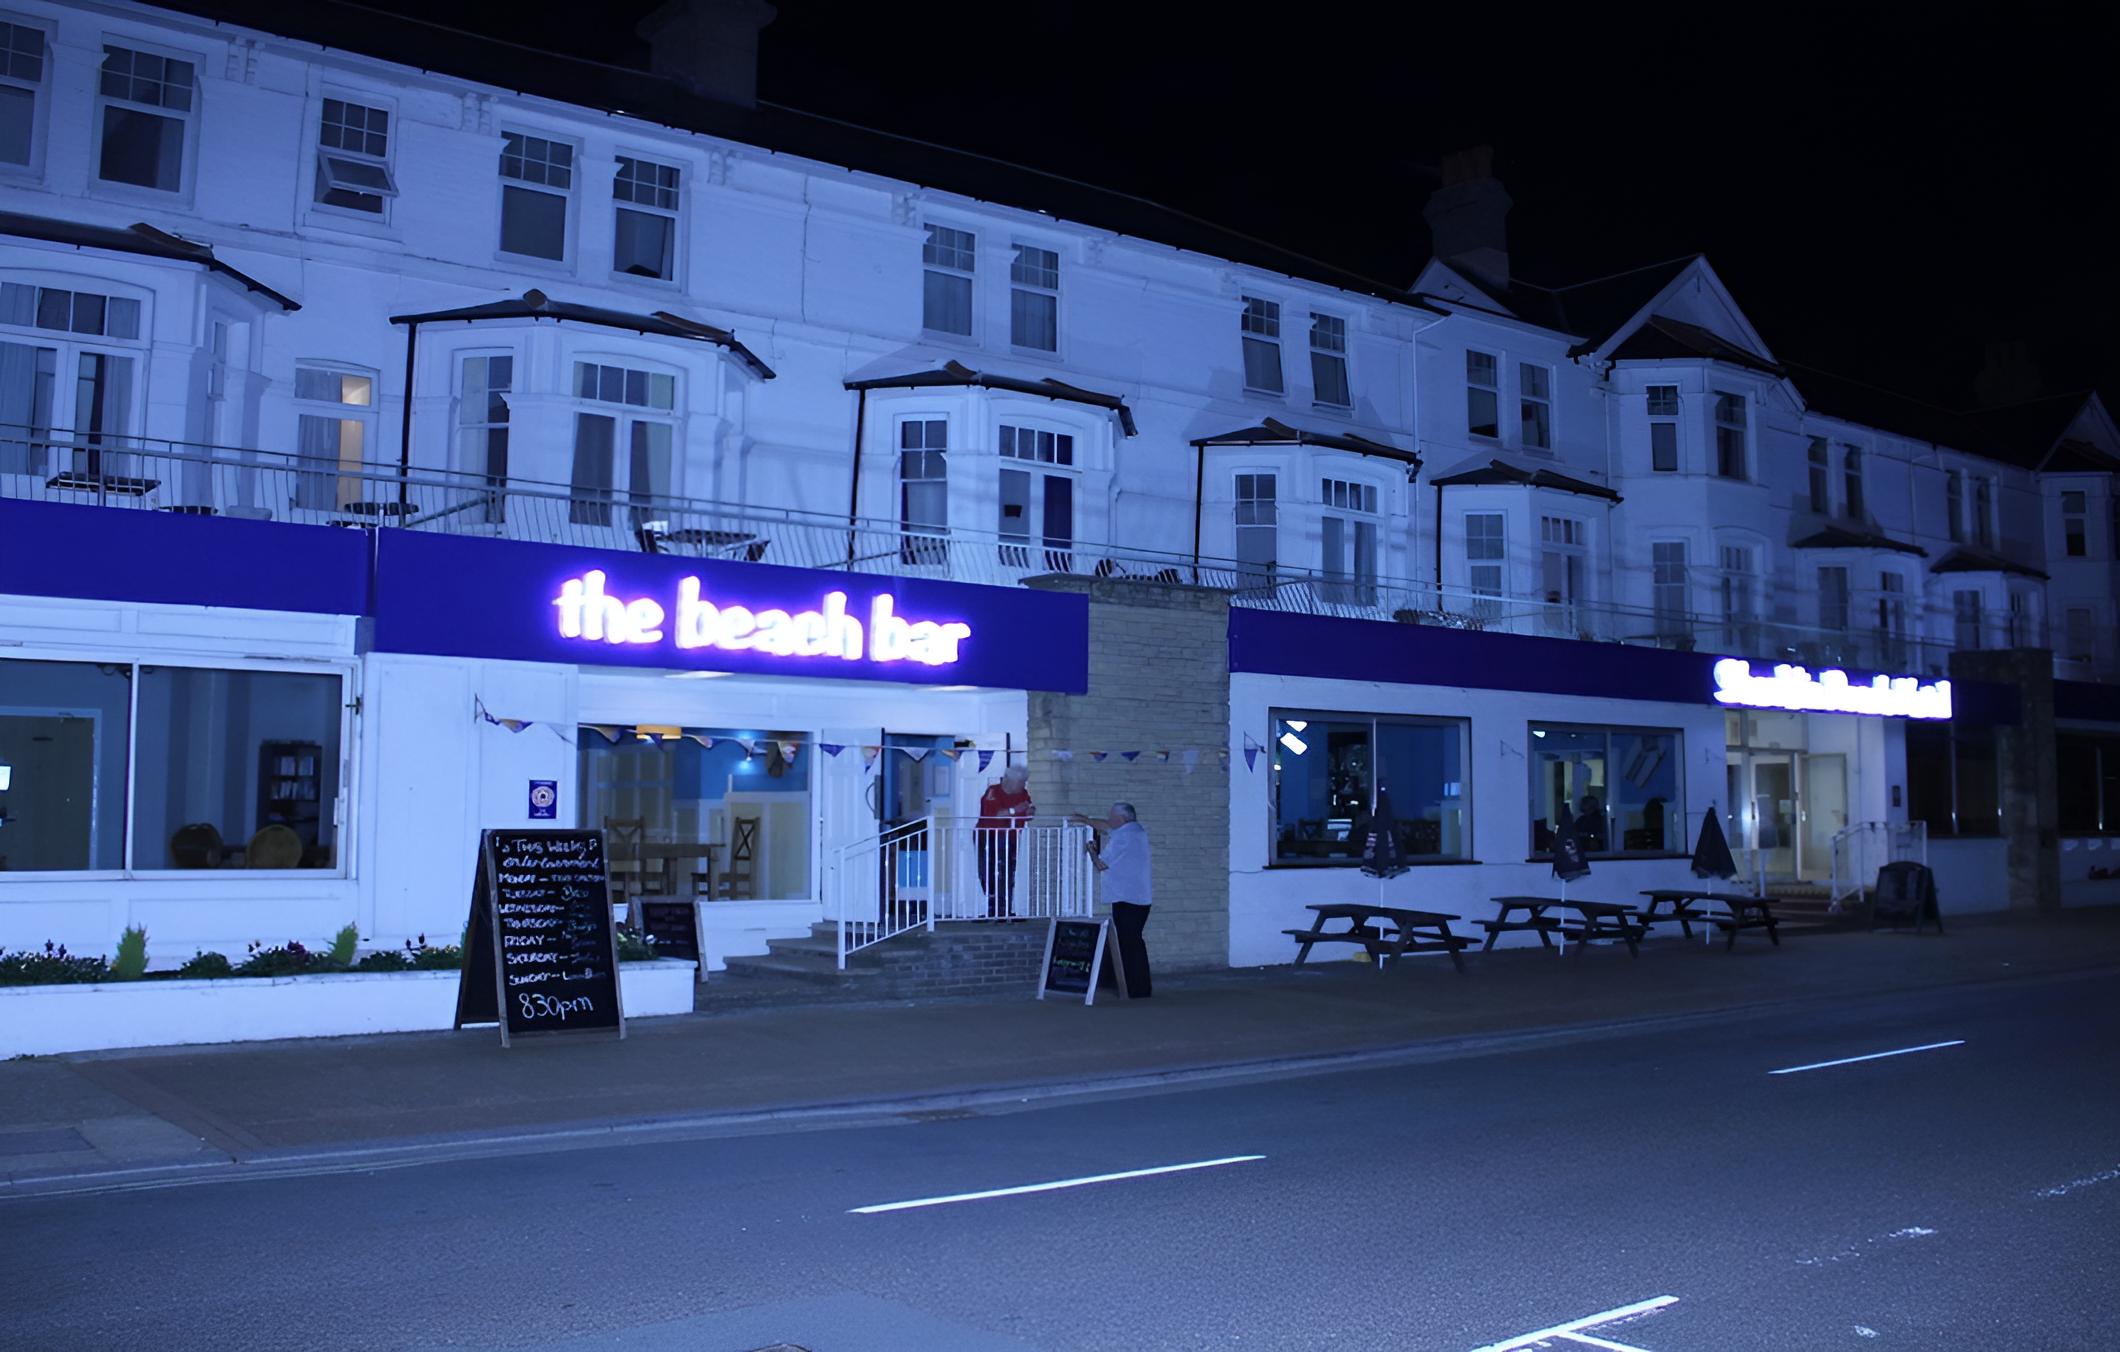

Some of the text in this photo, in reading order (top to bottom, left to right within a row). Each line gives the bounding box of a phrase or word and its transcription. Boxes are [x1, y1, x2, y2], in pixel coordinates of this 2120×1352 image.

[554, 570, 970, 666] the beach bar
[518, 992, 594, 1021] 830pm
